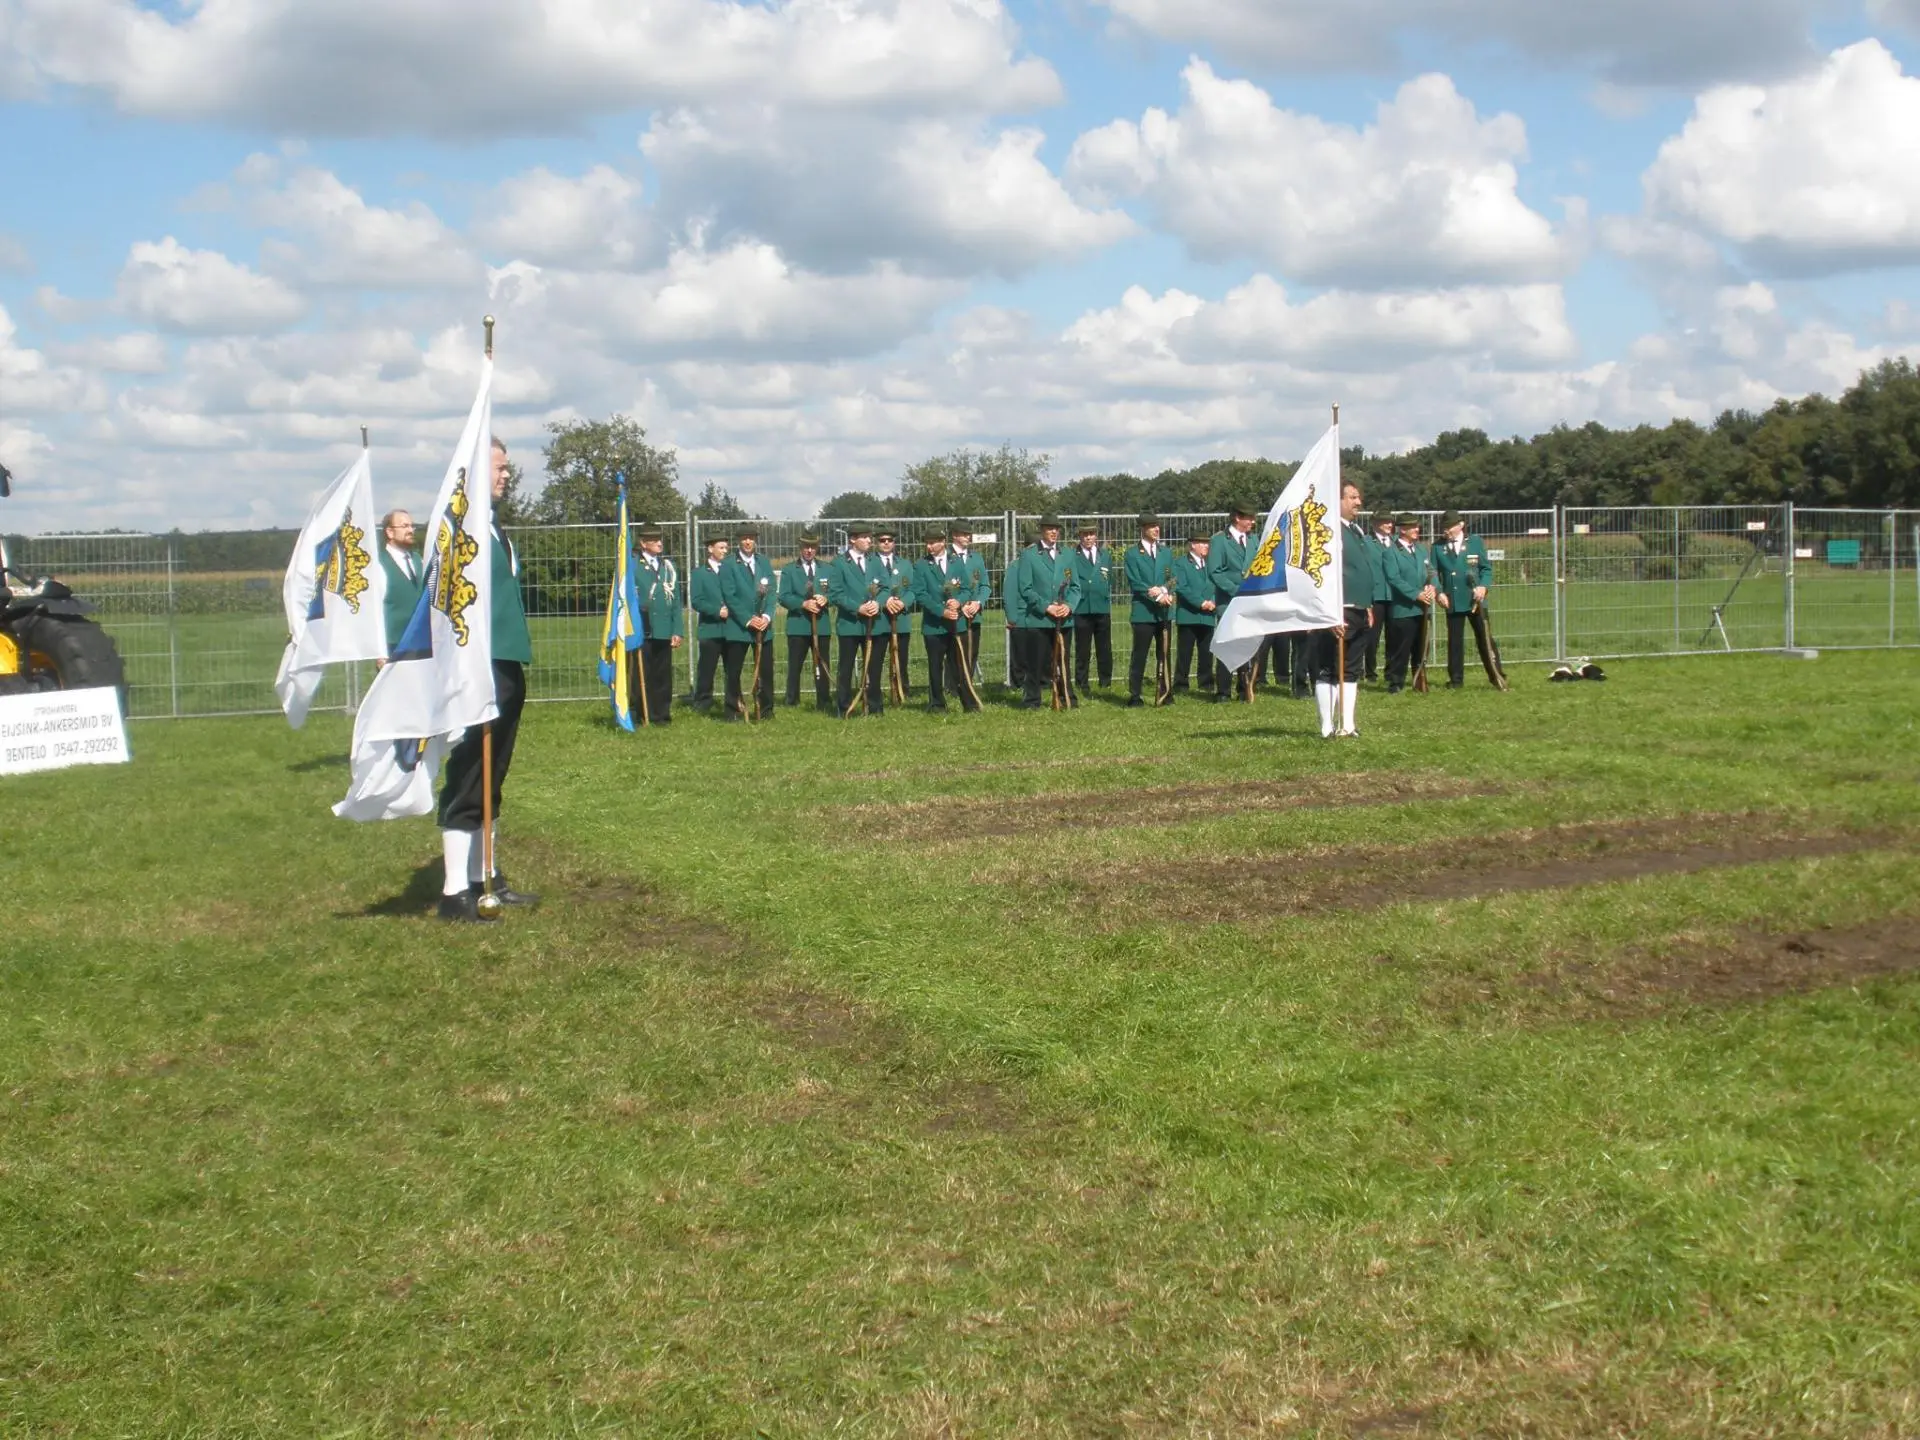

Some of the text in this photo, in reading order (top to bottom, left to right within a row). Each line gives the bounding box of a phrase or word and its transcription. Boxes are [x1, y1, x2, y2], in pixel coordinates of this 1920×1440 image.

[101, 714, 113, 728] BV
[6, 736, 119, 762] BENTELO 0547-292292
